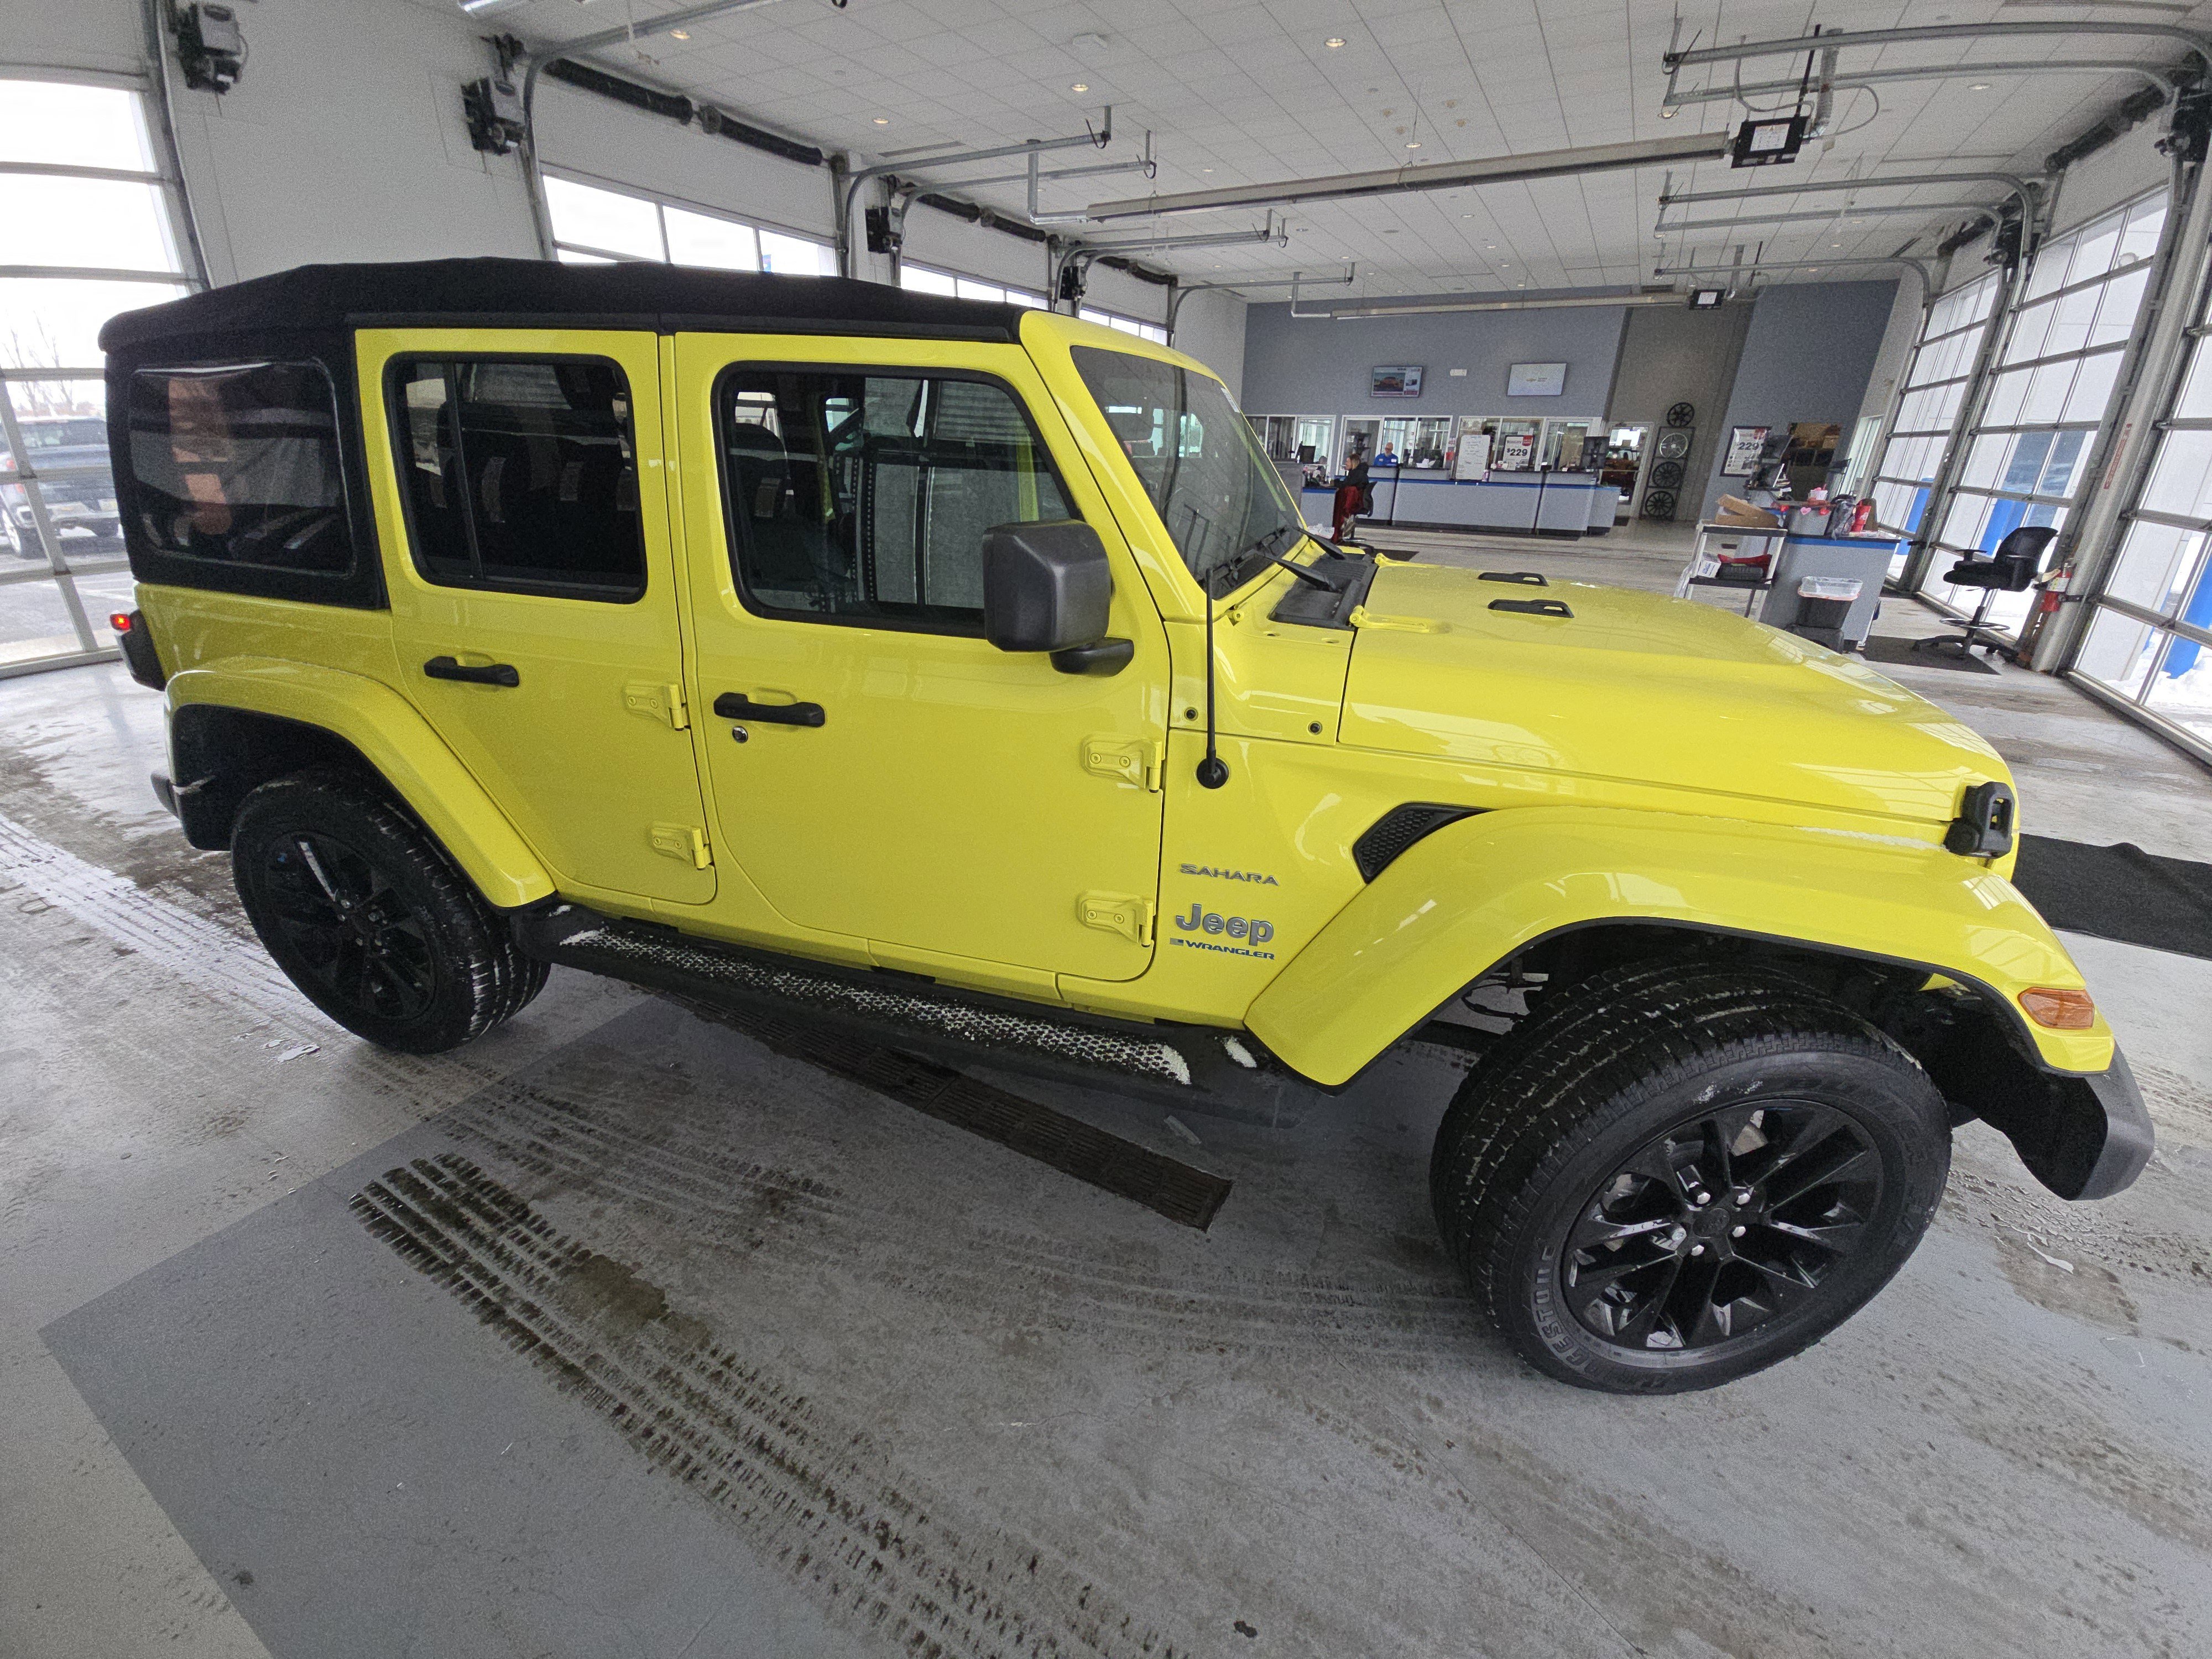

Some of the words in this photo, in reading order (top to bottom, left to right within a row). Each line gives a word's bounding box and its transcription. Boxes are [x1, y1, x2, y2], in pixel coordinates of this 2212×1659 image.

[1180, 863, 1279, 886] SAHARA
[1175, 903, 1274, 946] Jeep
[1185, 940, 1275, 960] WRANGLER
